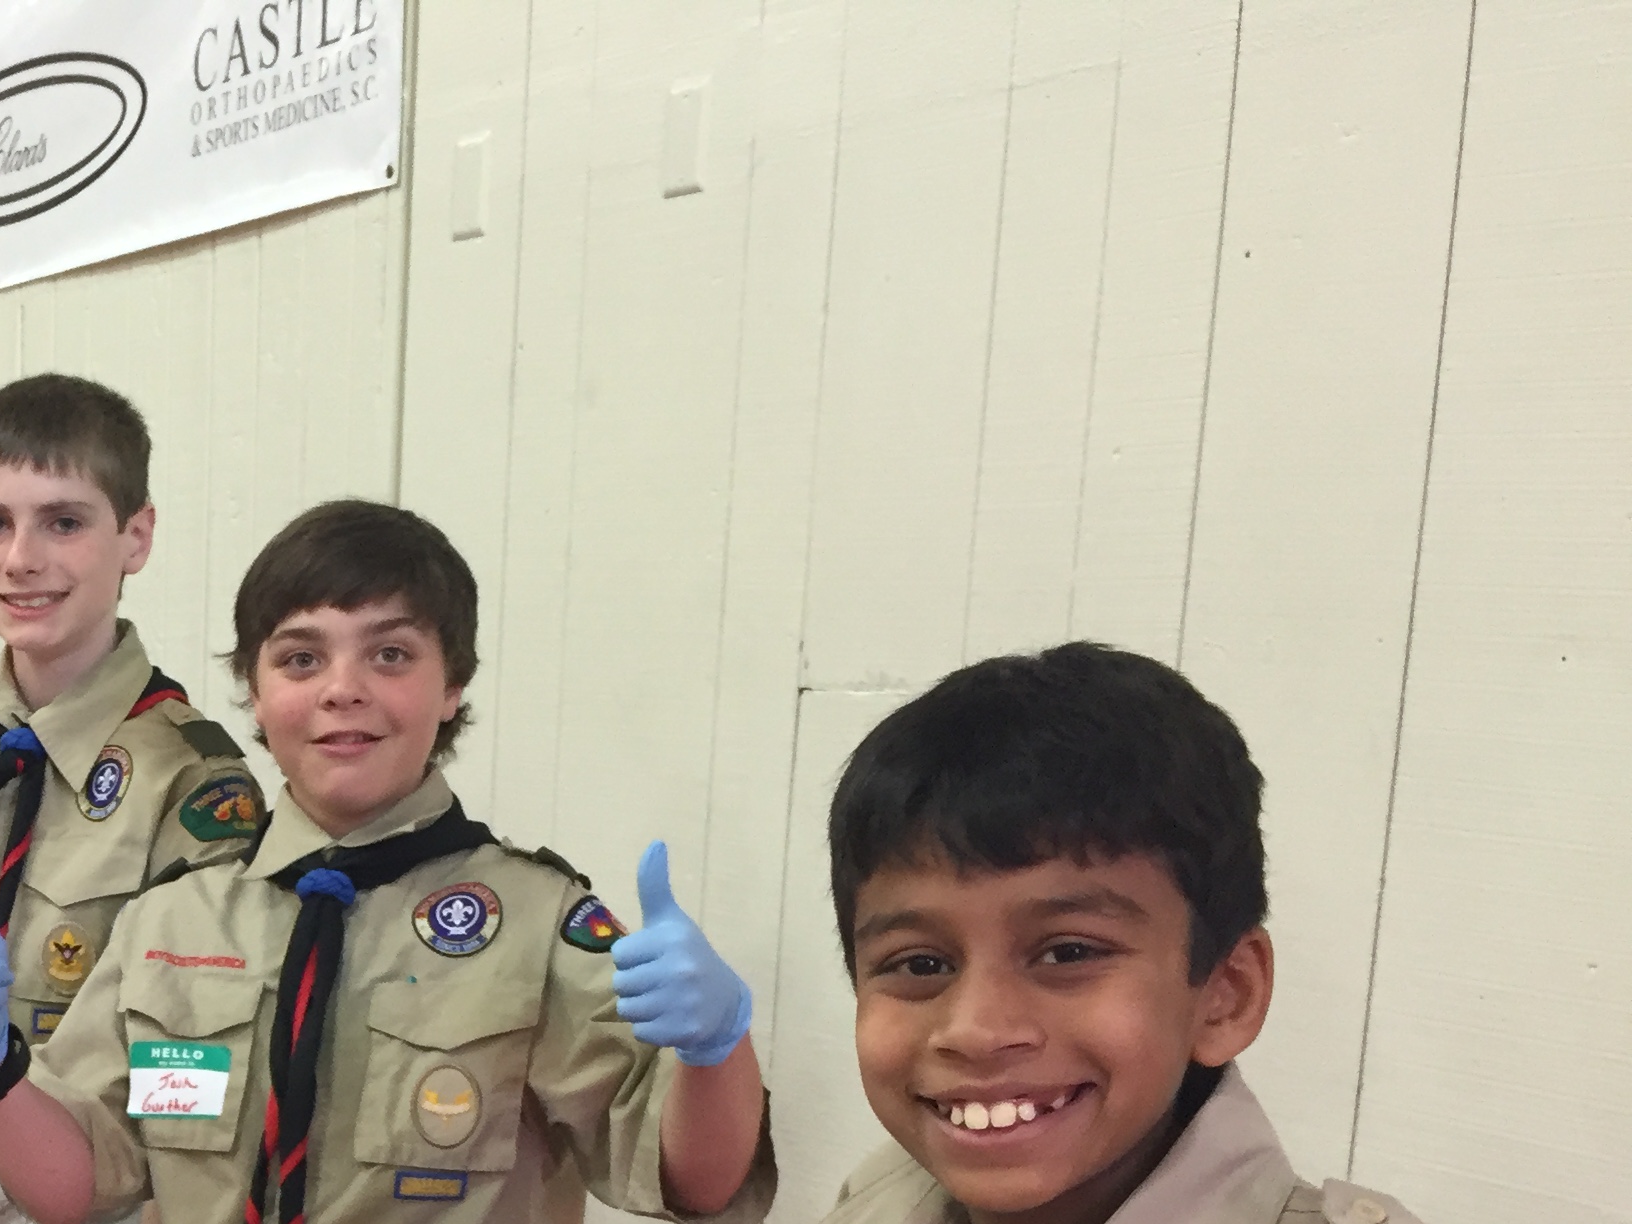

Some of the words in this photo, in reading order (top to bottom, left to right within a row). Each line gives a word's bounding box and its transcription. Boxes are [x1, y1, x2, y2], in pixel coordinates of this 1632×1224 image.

[191, 38, 377, 125] ORTHOPAEDICS
[206, 115, 259, 153] SPORTS
[151, 1047, 204, 1060] HELLO
